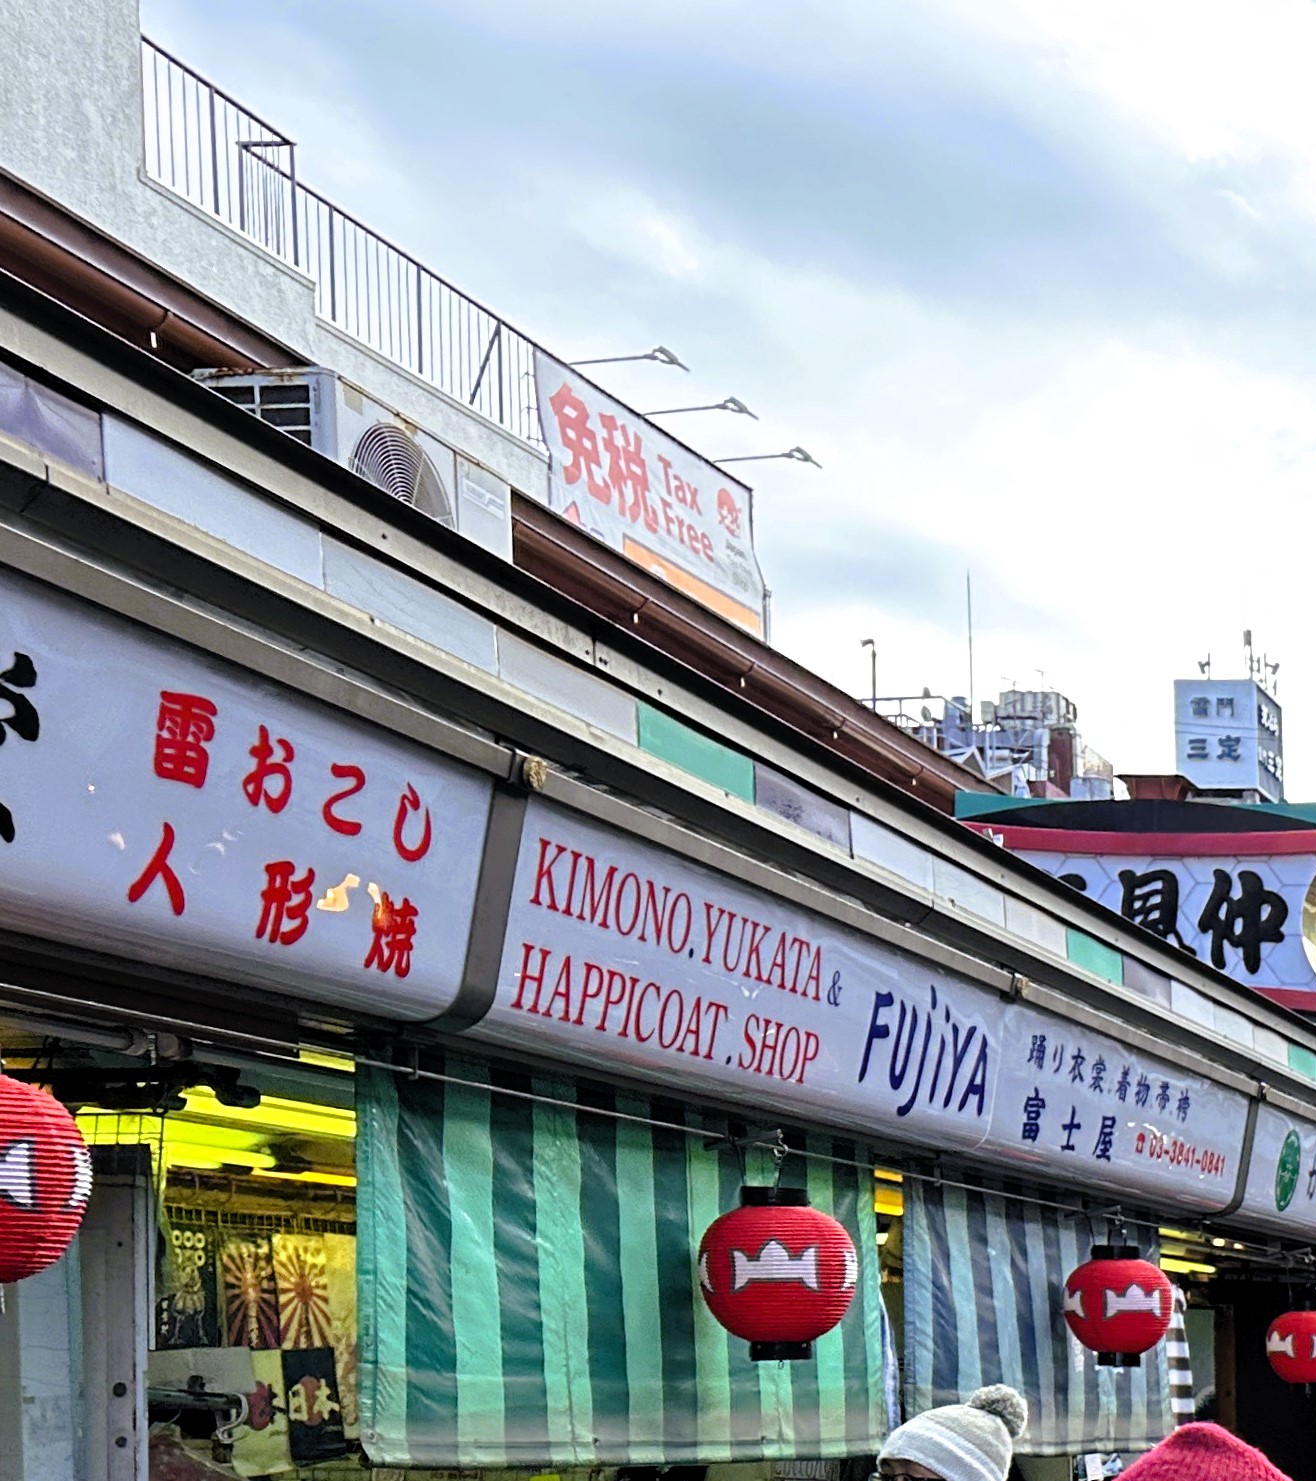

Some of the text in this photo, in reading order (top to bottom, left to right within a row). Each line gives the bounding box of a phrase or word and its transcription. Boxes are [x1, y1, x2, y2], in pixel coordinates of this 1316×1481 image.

[549, 382, 659, 533] 免税
[657, 453, 702, 517] Tax
[658, 496, 715, 563] Free
[153, 689, 430, 863] 雷おこし
[127, 821, 419, 979] 人形焼
[826, 970, 842, 1007] &
[1022, 1086, 1117, 1163] 富士屋
